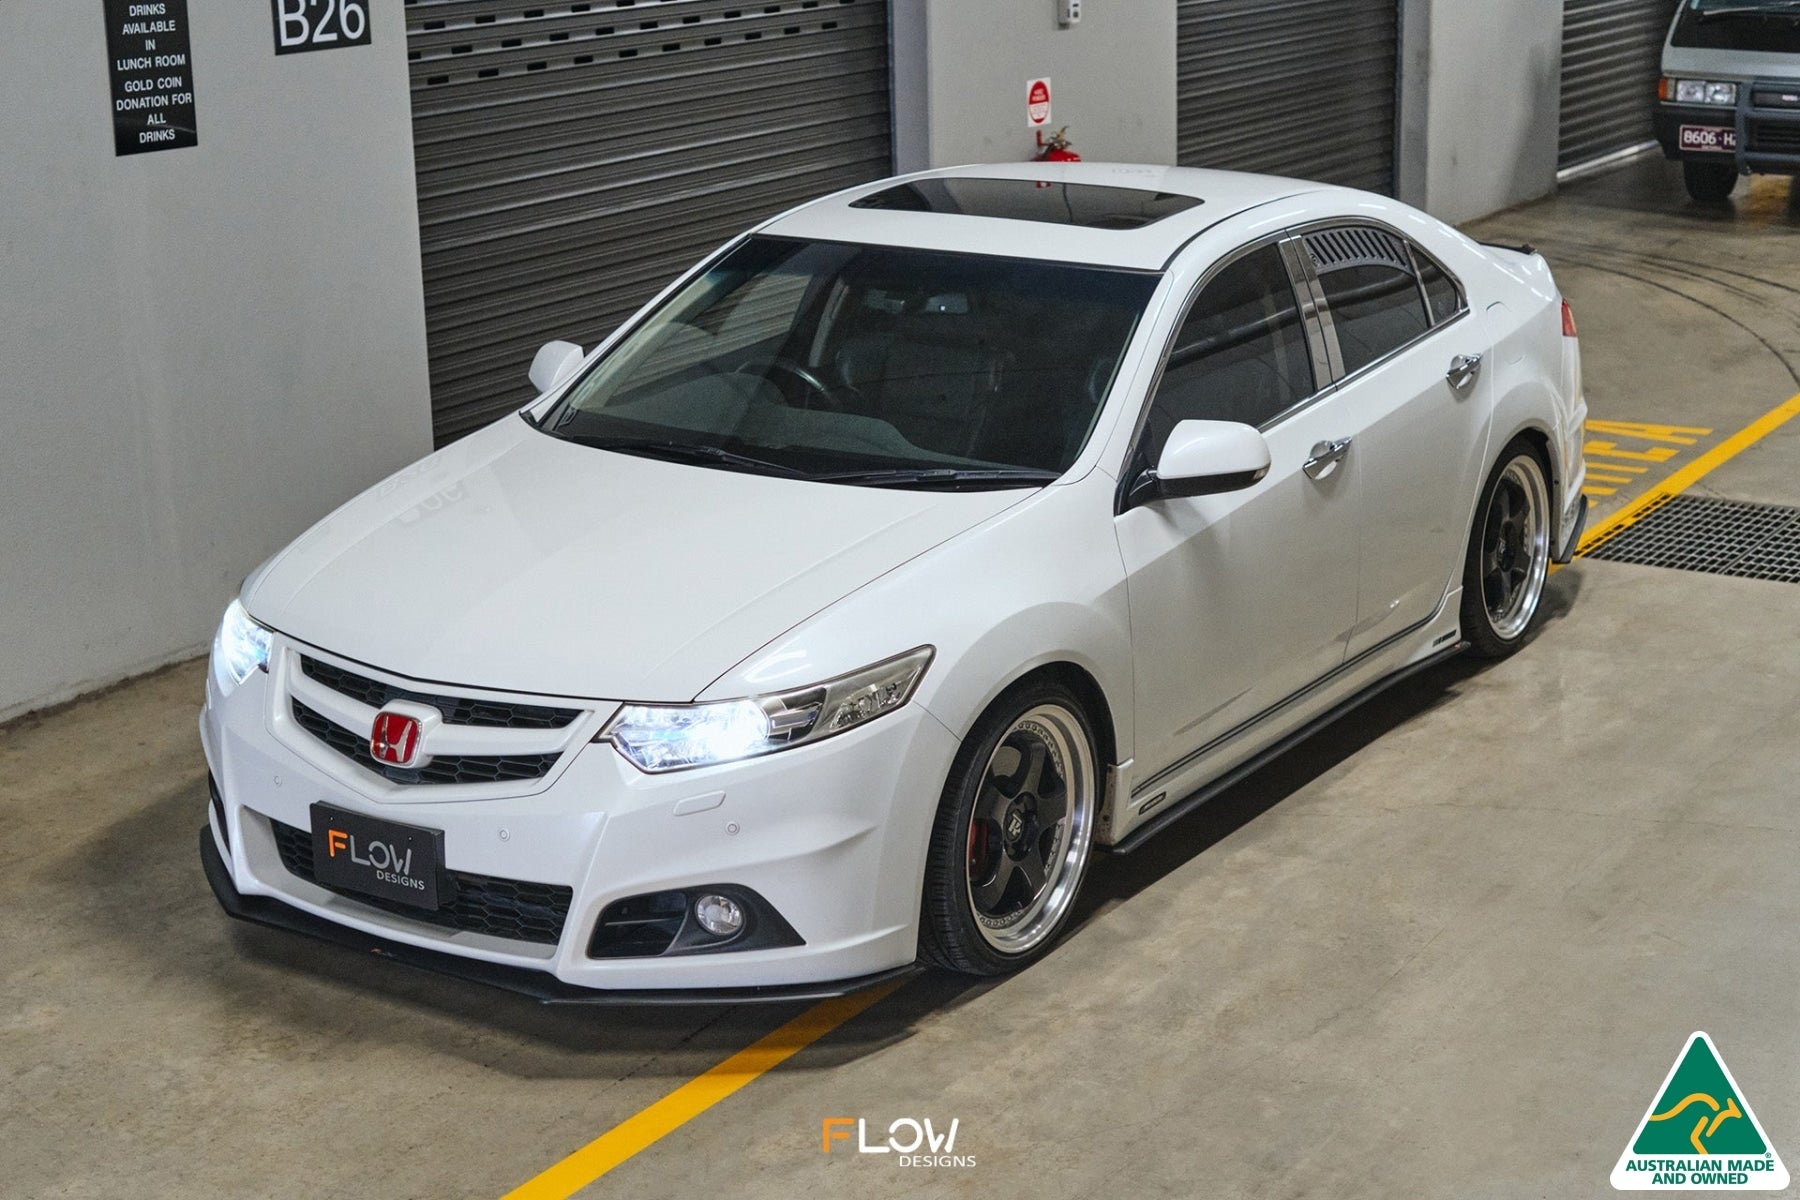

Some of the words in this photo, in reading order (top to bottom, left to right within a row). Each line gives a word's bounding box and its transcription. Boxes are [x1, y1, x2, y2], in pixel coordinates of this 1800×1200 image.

[128, 3, 166, 17] DRINKS
[122, 20, 176, 35] AVAILABLE
[277, 0, 366, 47] B26
[144, 39, 156, 51] IN
[116, 56, 152, 71] LUNCH
[155, 54, 186, 67] ROOM
[124, 79, 153, 93] GOLD
[157, 76, 182, 89] COIN
[116, 95, 169, 111] DONATION
[172, 92, 192, 105] FOR
[147, 113, 167, 125] ALL
[139, 129, 176, 143] DRINKS
[328, 829, 412, 875] FLOW
[376, 869, 425, 890] DESIGNS
